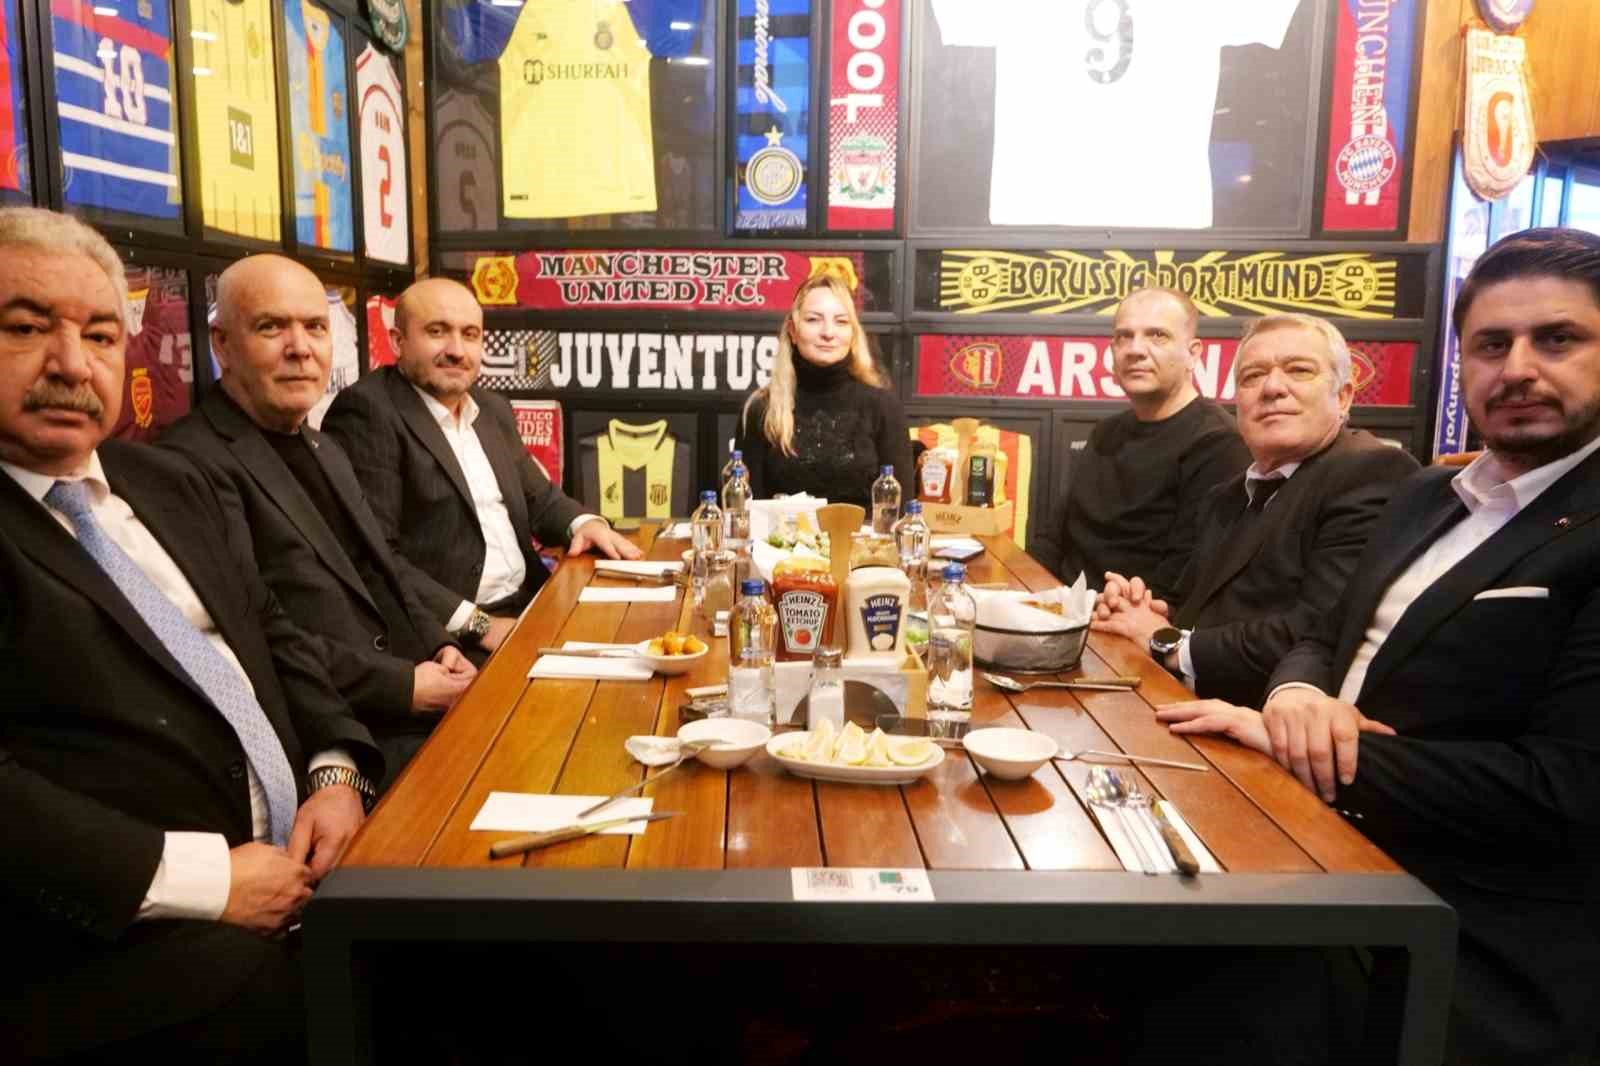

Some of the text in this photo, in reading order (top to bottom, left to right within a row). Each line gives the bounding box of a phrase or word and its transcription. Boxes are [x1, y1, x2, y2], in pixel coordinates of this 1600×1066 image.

[97, 36, 147, 126] 10
[547, 62, 629, 81] SHURFAH
[832, 0, 886, 124] OOL
[230, 119, 251, 157] 1&1
[378, 144, 392, 229] 2
[537, 252, 788, 278] MANCHESTER
[972, 263, 997, 299] BVB
[1009, 260, 1146, 300] BORUSSIA
[1157, 261, 1323, 302] DORTMUND
[1335, 264, 1364, 302] BVB
[561, 279, 766, 304] UNITED F.C.
[550, 333, 779, 389] JUVENTUS
[785, 607, 821, 618] TOMATO
[788, 595, 817, 606] HEINZ
[870, 596, 896, 609] HEINZ
